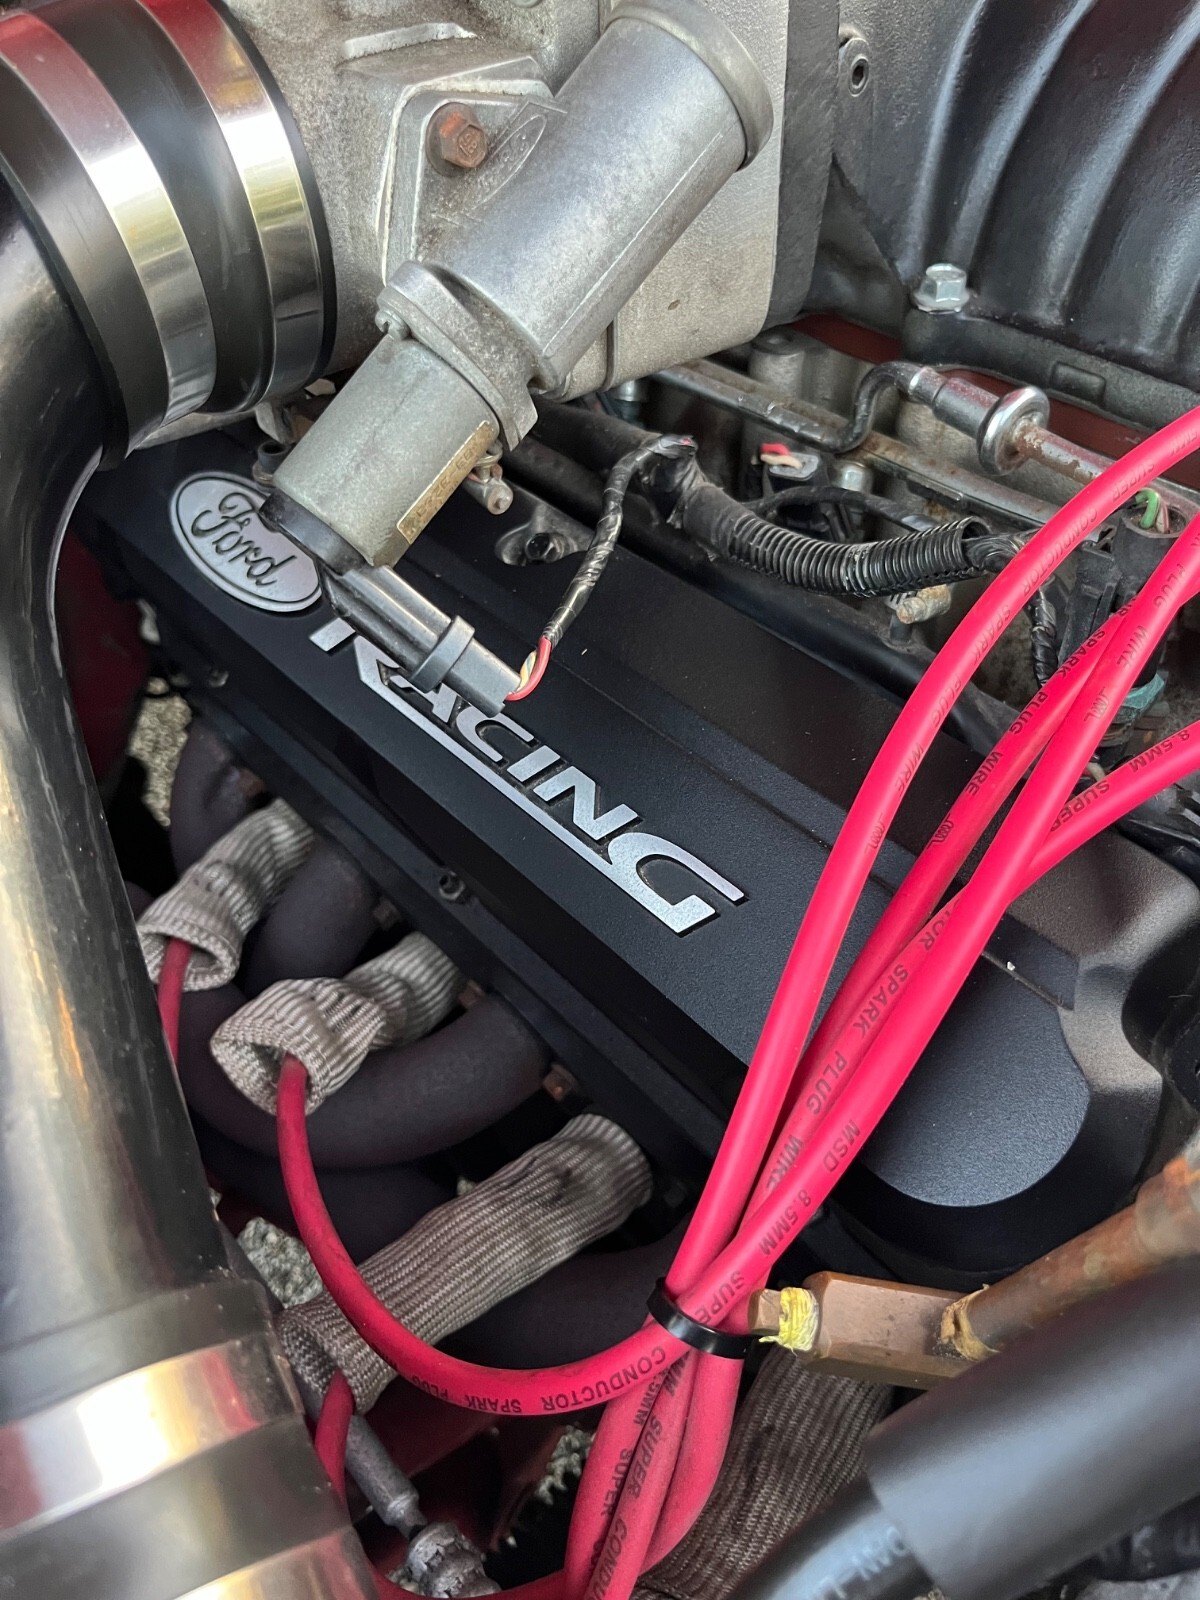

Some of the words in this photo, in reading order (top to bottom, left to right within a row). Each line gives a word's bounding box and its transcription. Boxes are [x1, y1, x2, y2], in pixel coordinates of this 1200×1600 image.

[190, 492, 298, 587] Ford
[1022, 508, 1098, 597] CONDUCTOR
[1154, 563, 1187, 608] PLUG
[973, 604, 1011, 664] SPARK
[1056, 630, 1106, 679] SPARK
[931, 675, 962, 729] PLUG
[1009, 691, 1048, 735] PLUG
[895, 742, 924, 793] WIRE
[965, 751, 1004, 797] WIRE
[1129, 730, 1190, 772] 8.5MM
[852, 964, 909, 1039] SPARK
[807, 1051, 848, 1116] PLUG
[823, 1119, 861, 1173] MSD
[758, 1189, 812, 1256] 8.5MM
[695, 1270, 745, 1324] SUPE
[465, 1393, 523, 1414] SPARK
[541, 1346, 667, 1410] CONDUCTOR
[627, 1414, 664, 1498] SUPER
[589, 1518, 628, 1600] CONDU
